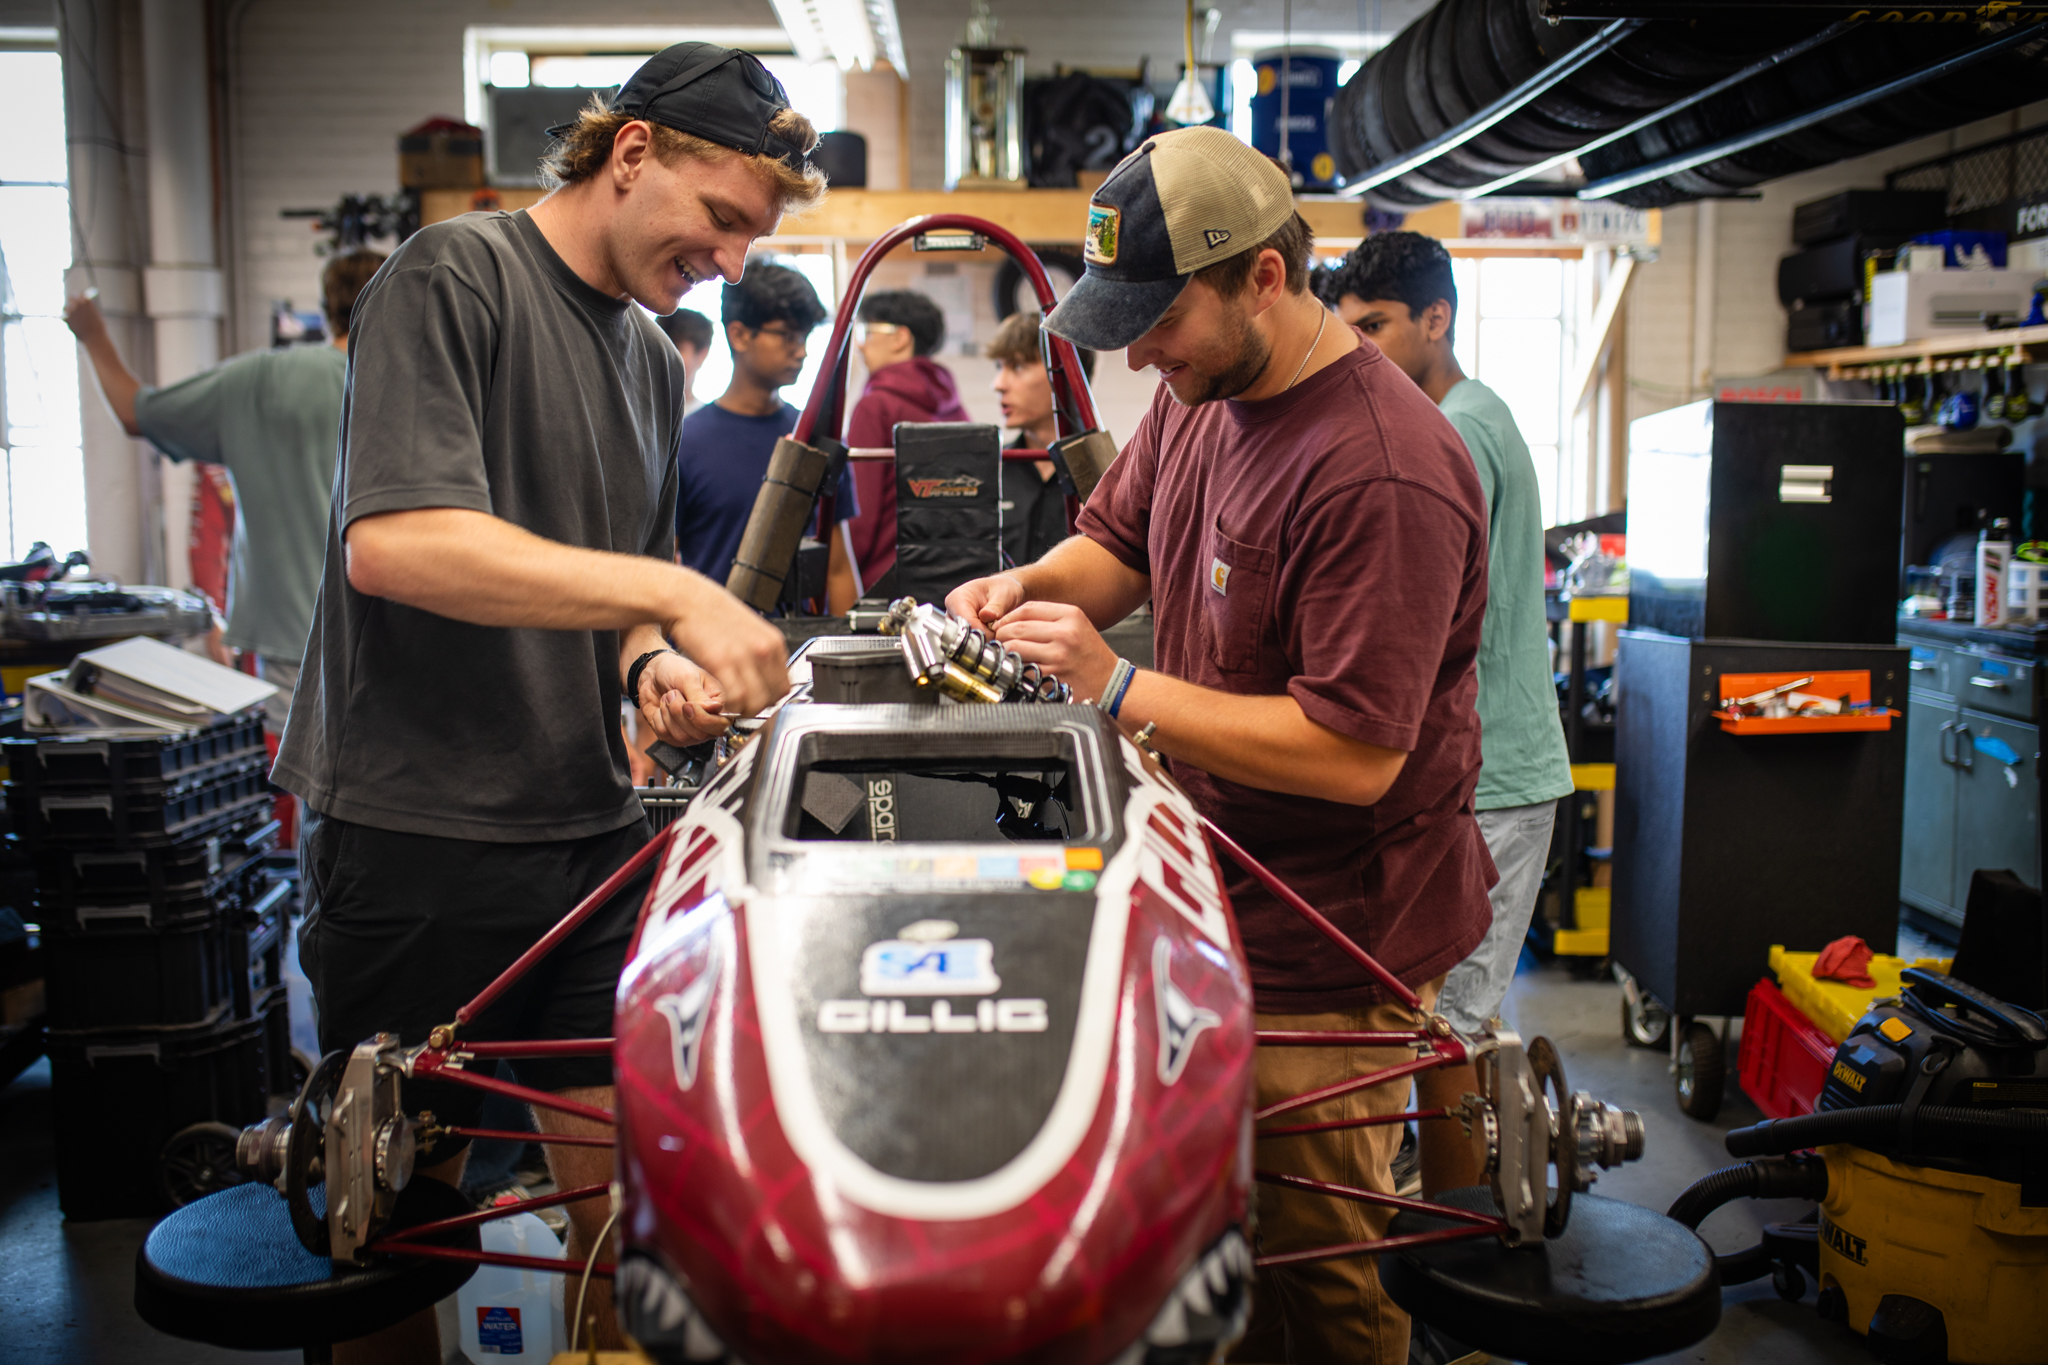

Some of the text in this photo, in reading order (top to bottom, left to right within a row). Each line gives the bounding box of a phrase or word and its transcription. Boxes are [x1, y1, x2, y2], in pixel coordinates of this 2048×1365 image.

[817, 998, 1049, 1033] GILLIG
[1820, 1218, 1867, 1264] WALT
[482, 1322, 517, 1331] WATER
